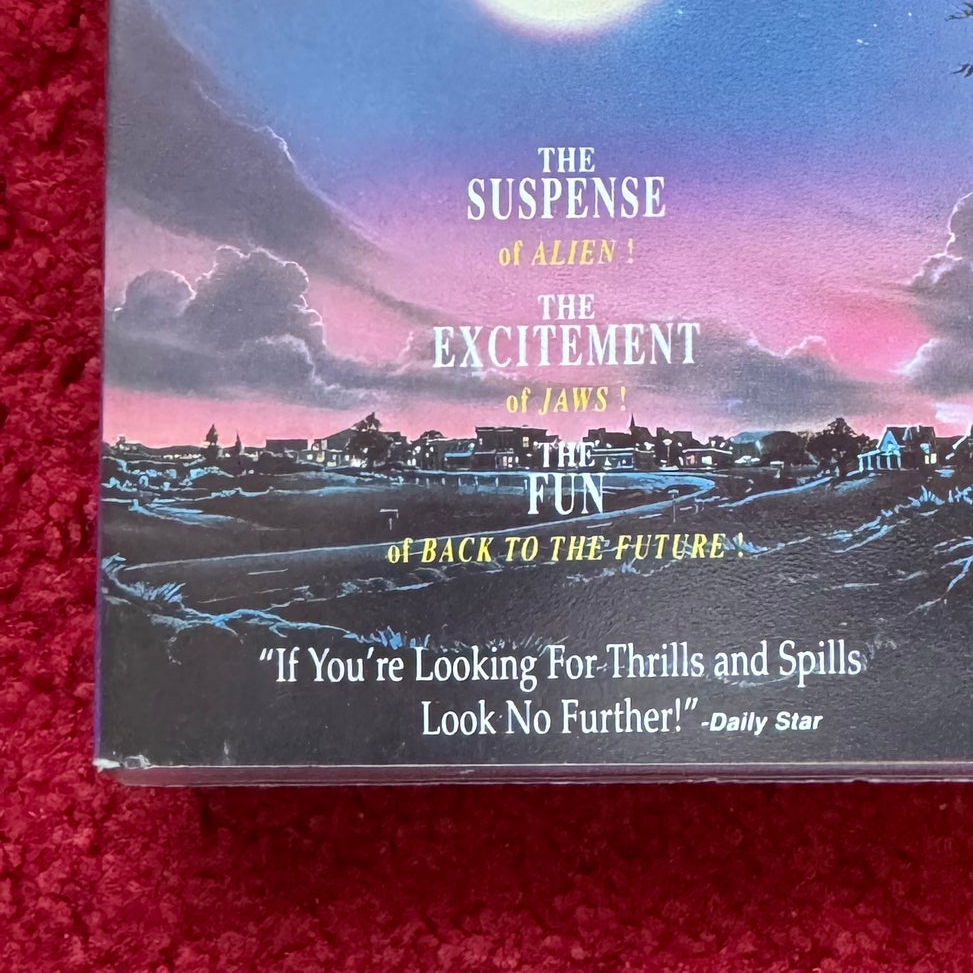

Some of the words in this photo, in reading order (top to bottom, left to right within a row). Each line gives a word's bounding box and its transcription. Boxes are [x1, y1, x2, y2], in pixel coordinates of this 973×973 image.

[537, 146, 597, 174] THE
[466, 176, 667, 221] SUSPENSE
[498, 239, 525, 266] of
[530, 237, 618, 267] ALIEN
[537, 293, 596, 321] THE
[432, 322, 702, 369] EXCITEMENT
[505, 386, 532, 413] of
[537, 386, 609, 416] JAWS
[535, 441, 598, 468] THE
[526, 472, 606, 516] FUN
[388, 538, 414, 564] of
[421, 536, 496, 564] BACK
[504, 536, 541, 562] TO
[549, 535, 605, 561] THE
[612, 533, 729, 560] FUTURE
[413, 643, 538, 692] Looking
[547, 644, 597, 679] For
[606, 641, 705, 677] Thrills
[713, 639, 769, 676] and
[778, 639, 862, 688] Spills
[421, 699, 497, 735] Look
[505, 699, 551, 735] No
[774, 711, 823, 731] Star
